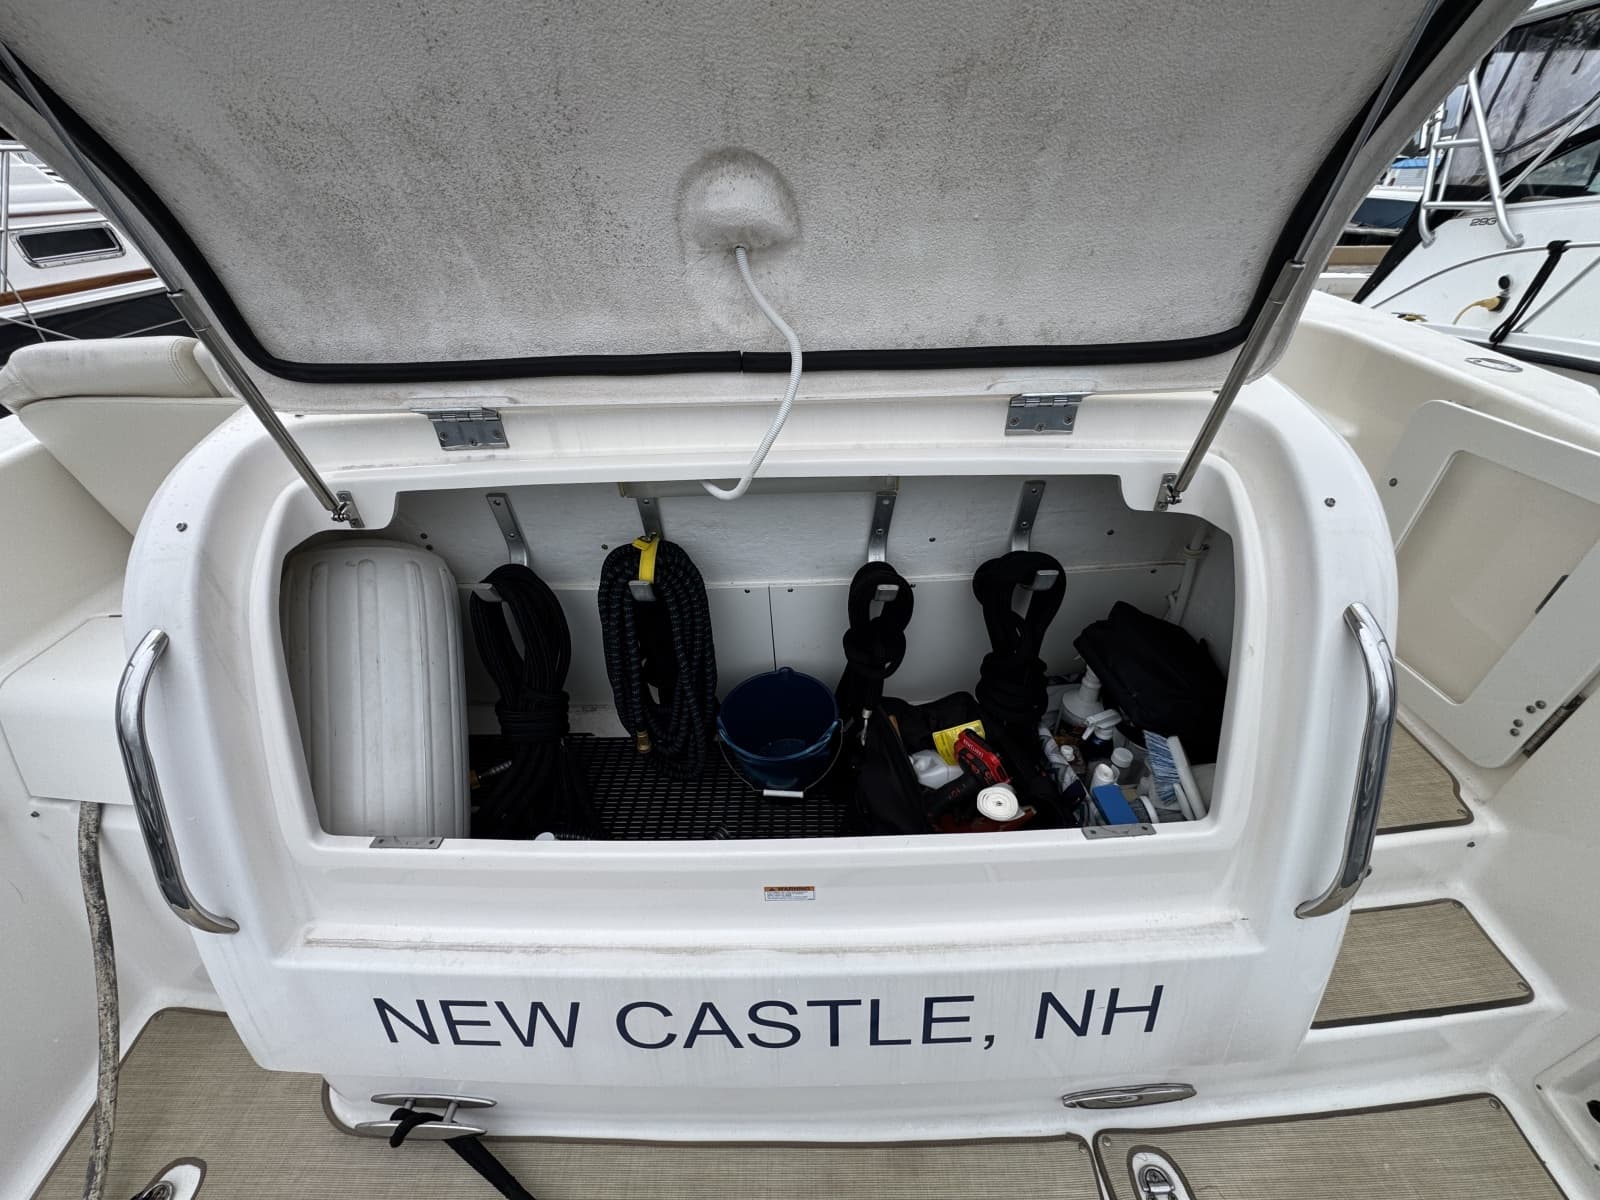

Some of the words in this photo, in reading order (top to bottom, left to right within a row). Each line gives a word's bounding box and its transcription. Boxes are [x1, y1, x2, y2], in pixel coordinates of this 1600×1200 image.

[373, 997, 580, 1048] NEW
[615, 995, 995, 1050] CASTLE,
[1034, 984, 1164, 1040] NH
